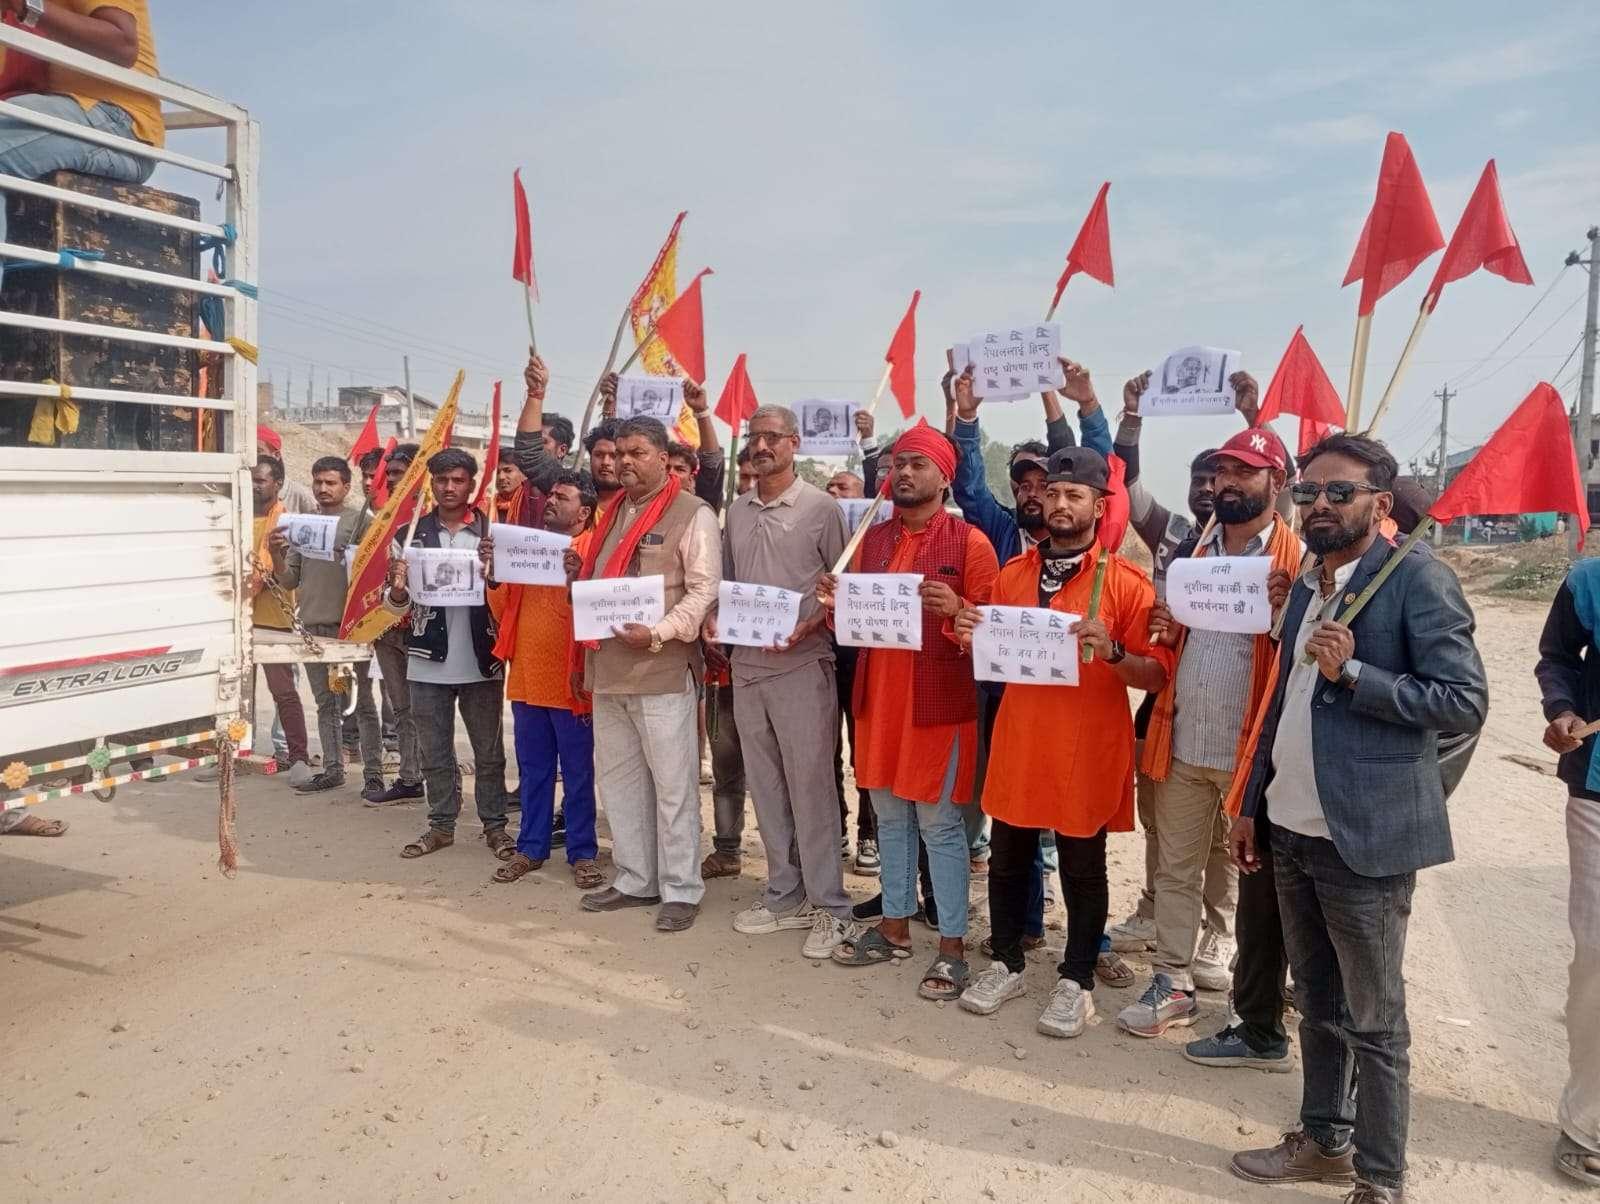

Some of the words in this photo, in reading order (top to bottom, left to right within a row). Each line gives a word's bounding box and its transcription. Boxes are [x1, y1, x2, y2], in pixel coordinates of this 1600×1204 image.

[1211, 563, 1232, 575] हामी
[1184, 580, 1212, 595] सुशीला
[1217, 581, 1241, 594] कार्की
[1246, 583, 1259, 595] को
[848, 597, 886, 611] नेपाललाई
[1190, 599, 1228, 613] समर्थनमा
[989, 624, 1014, 638] नेपाल
[13, 670, 110, 697] EXTRA
[113, 660, 182, 682] LONG
